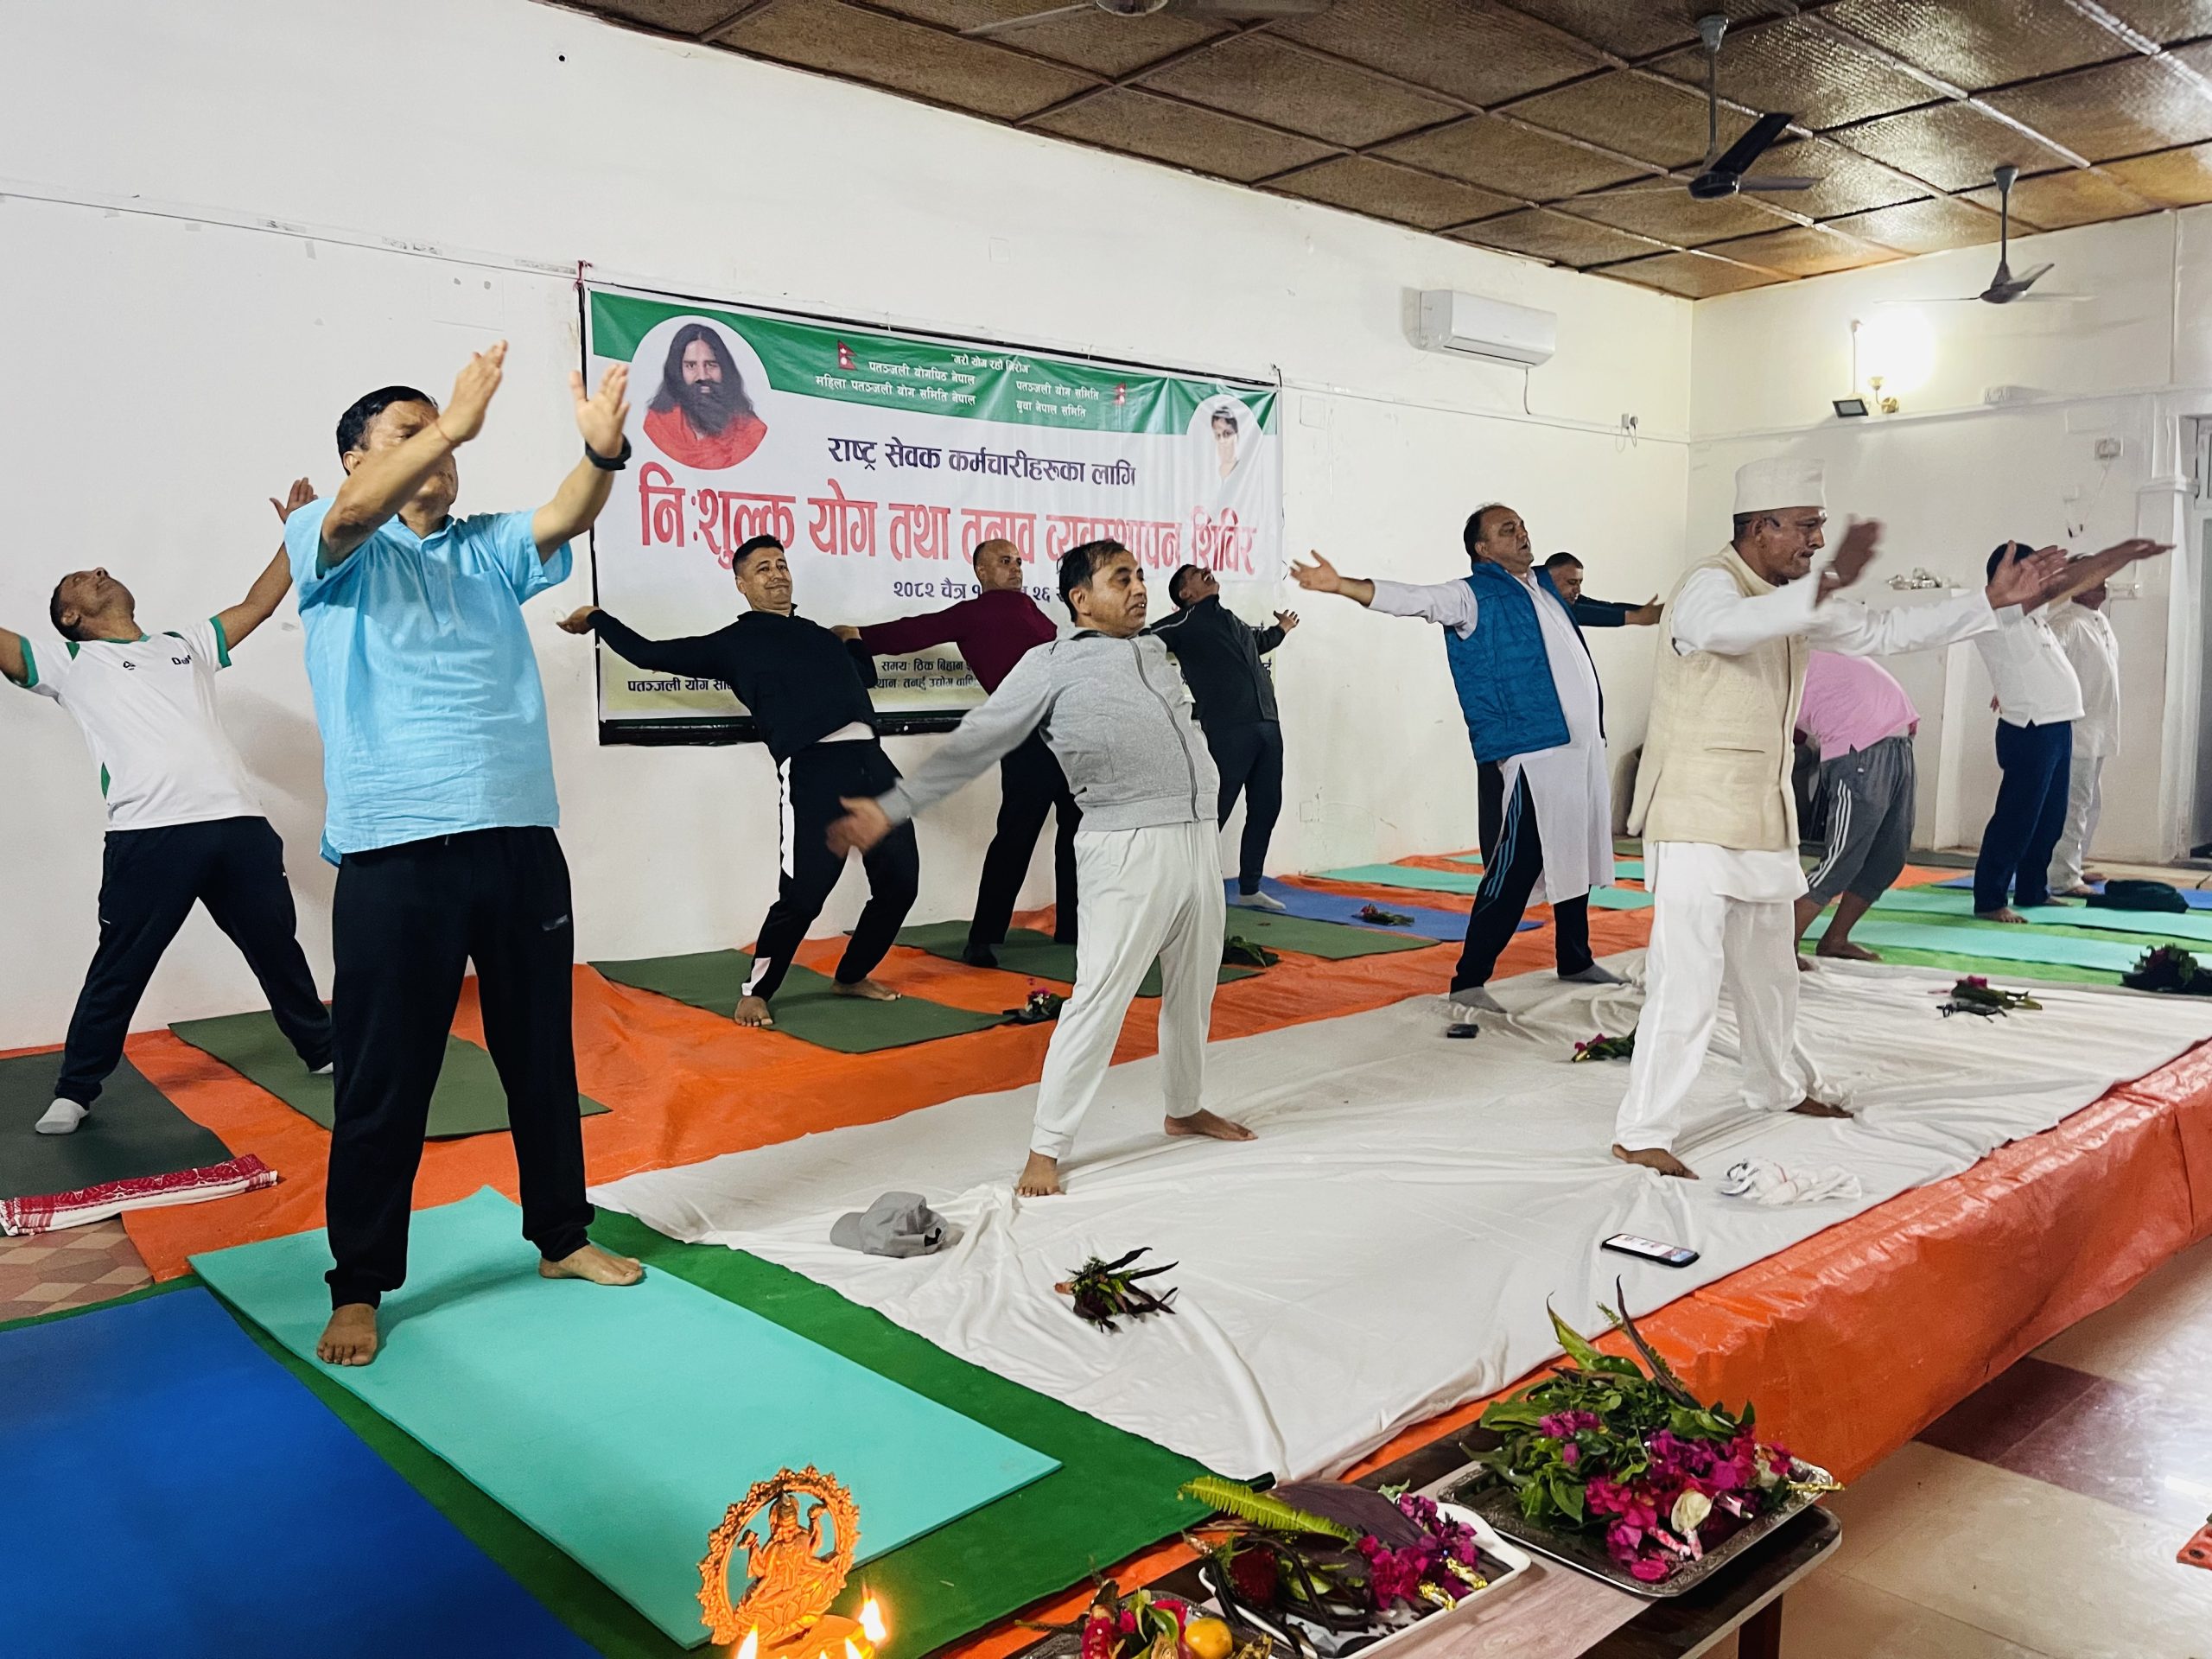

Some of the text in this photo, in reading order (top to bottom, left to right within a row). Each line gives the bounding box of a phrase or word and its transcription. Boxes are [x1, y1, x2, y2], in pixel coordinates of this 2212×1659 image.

[971, 355, 988, 368] योग
[951, 371, 976, 385] नेपाल
[815, 374, 847, 389] महिला
[897, 385, 915, 398] योग
[919, 387, 948, 402] समिति
[951, 391, 976, 405] नेपाल
[1055, 385, 1071, 397] योग
[1074, 387, 1099, 400] समिति
[1015, 399, 1087, 417] युवा नेपाल समिति
[827, 436, 877, 471] राष्ट्र
[884, 436, 942, 468] सेवक
[1091, 459, 1136, 486] लागि
[807, 478, 878, 557] योग
[888, 503, 951, 562] तथा
[960, 508, 1037, 564] तनाव
[1191, 505, 1257, 575] शिविर
[893, 581, 935, 598] २०८२
[940, 577, 967, 599] चैत्र
[1033, 586, 1052, 603] २६
[913, 658, 934, 671] ठिक
[937, 658, 963, 672] बिहान
[684, 677, 709, 690] योग
